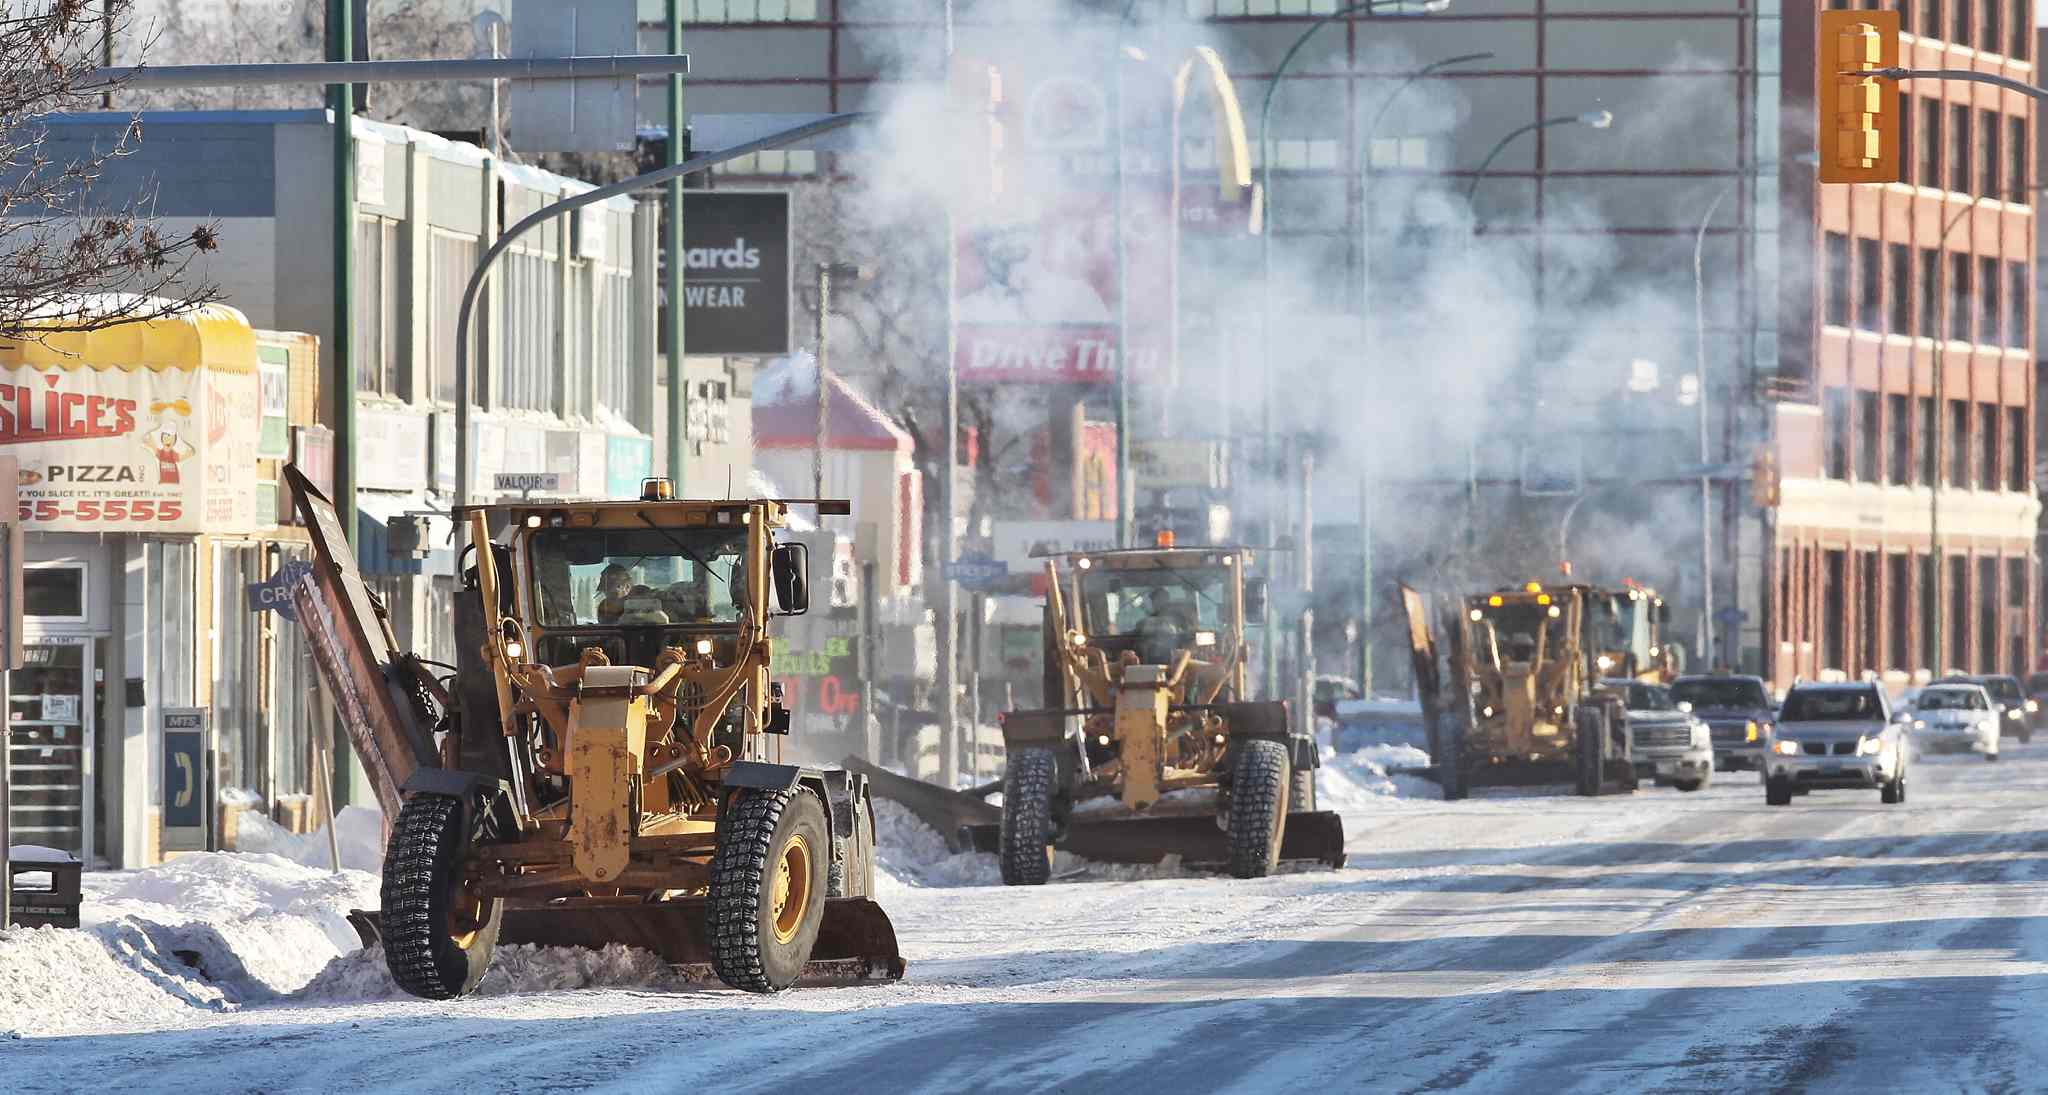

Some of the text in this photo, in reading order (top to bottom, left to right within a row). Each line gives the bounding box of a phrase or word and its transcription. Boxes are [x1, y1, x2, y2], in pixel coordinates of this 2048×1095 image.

[969, 339, 1069, 370] Drive
[47, 465, 136, 483] PIZZA
[27, 490, 46, 498] YOU
[47, 490, 75, 498] SLICE
